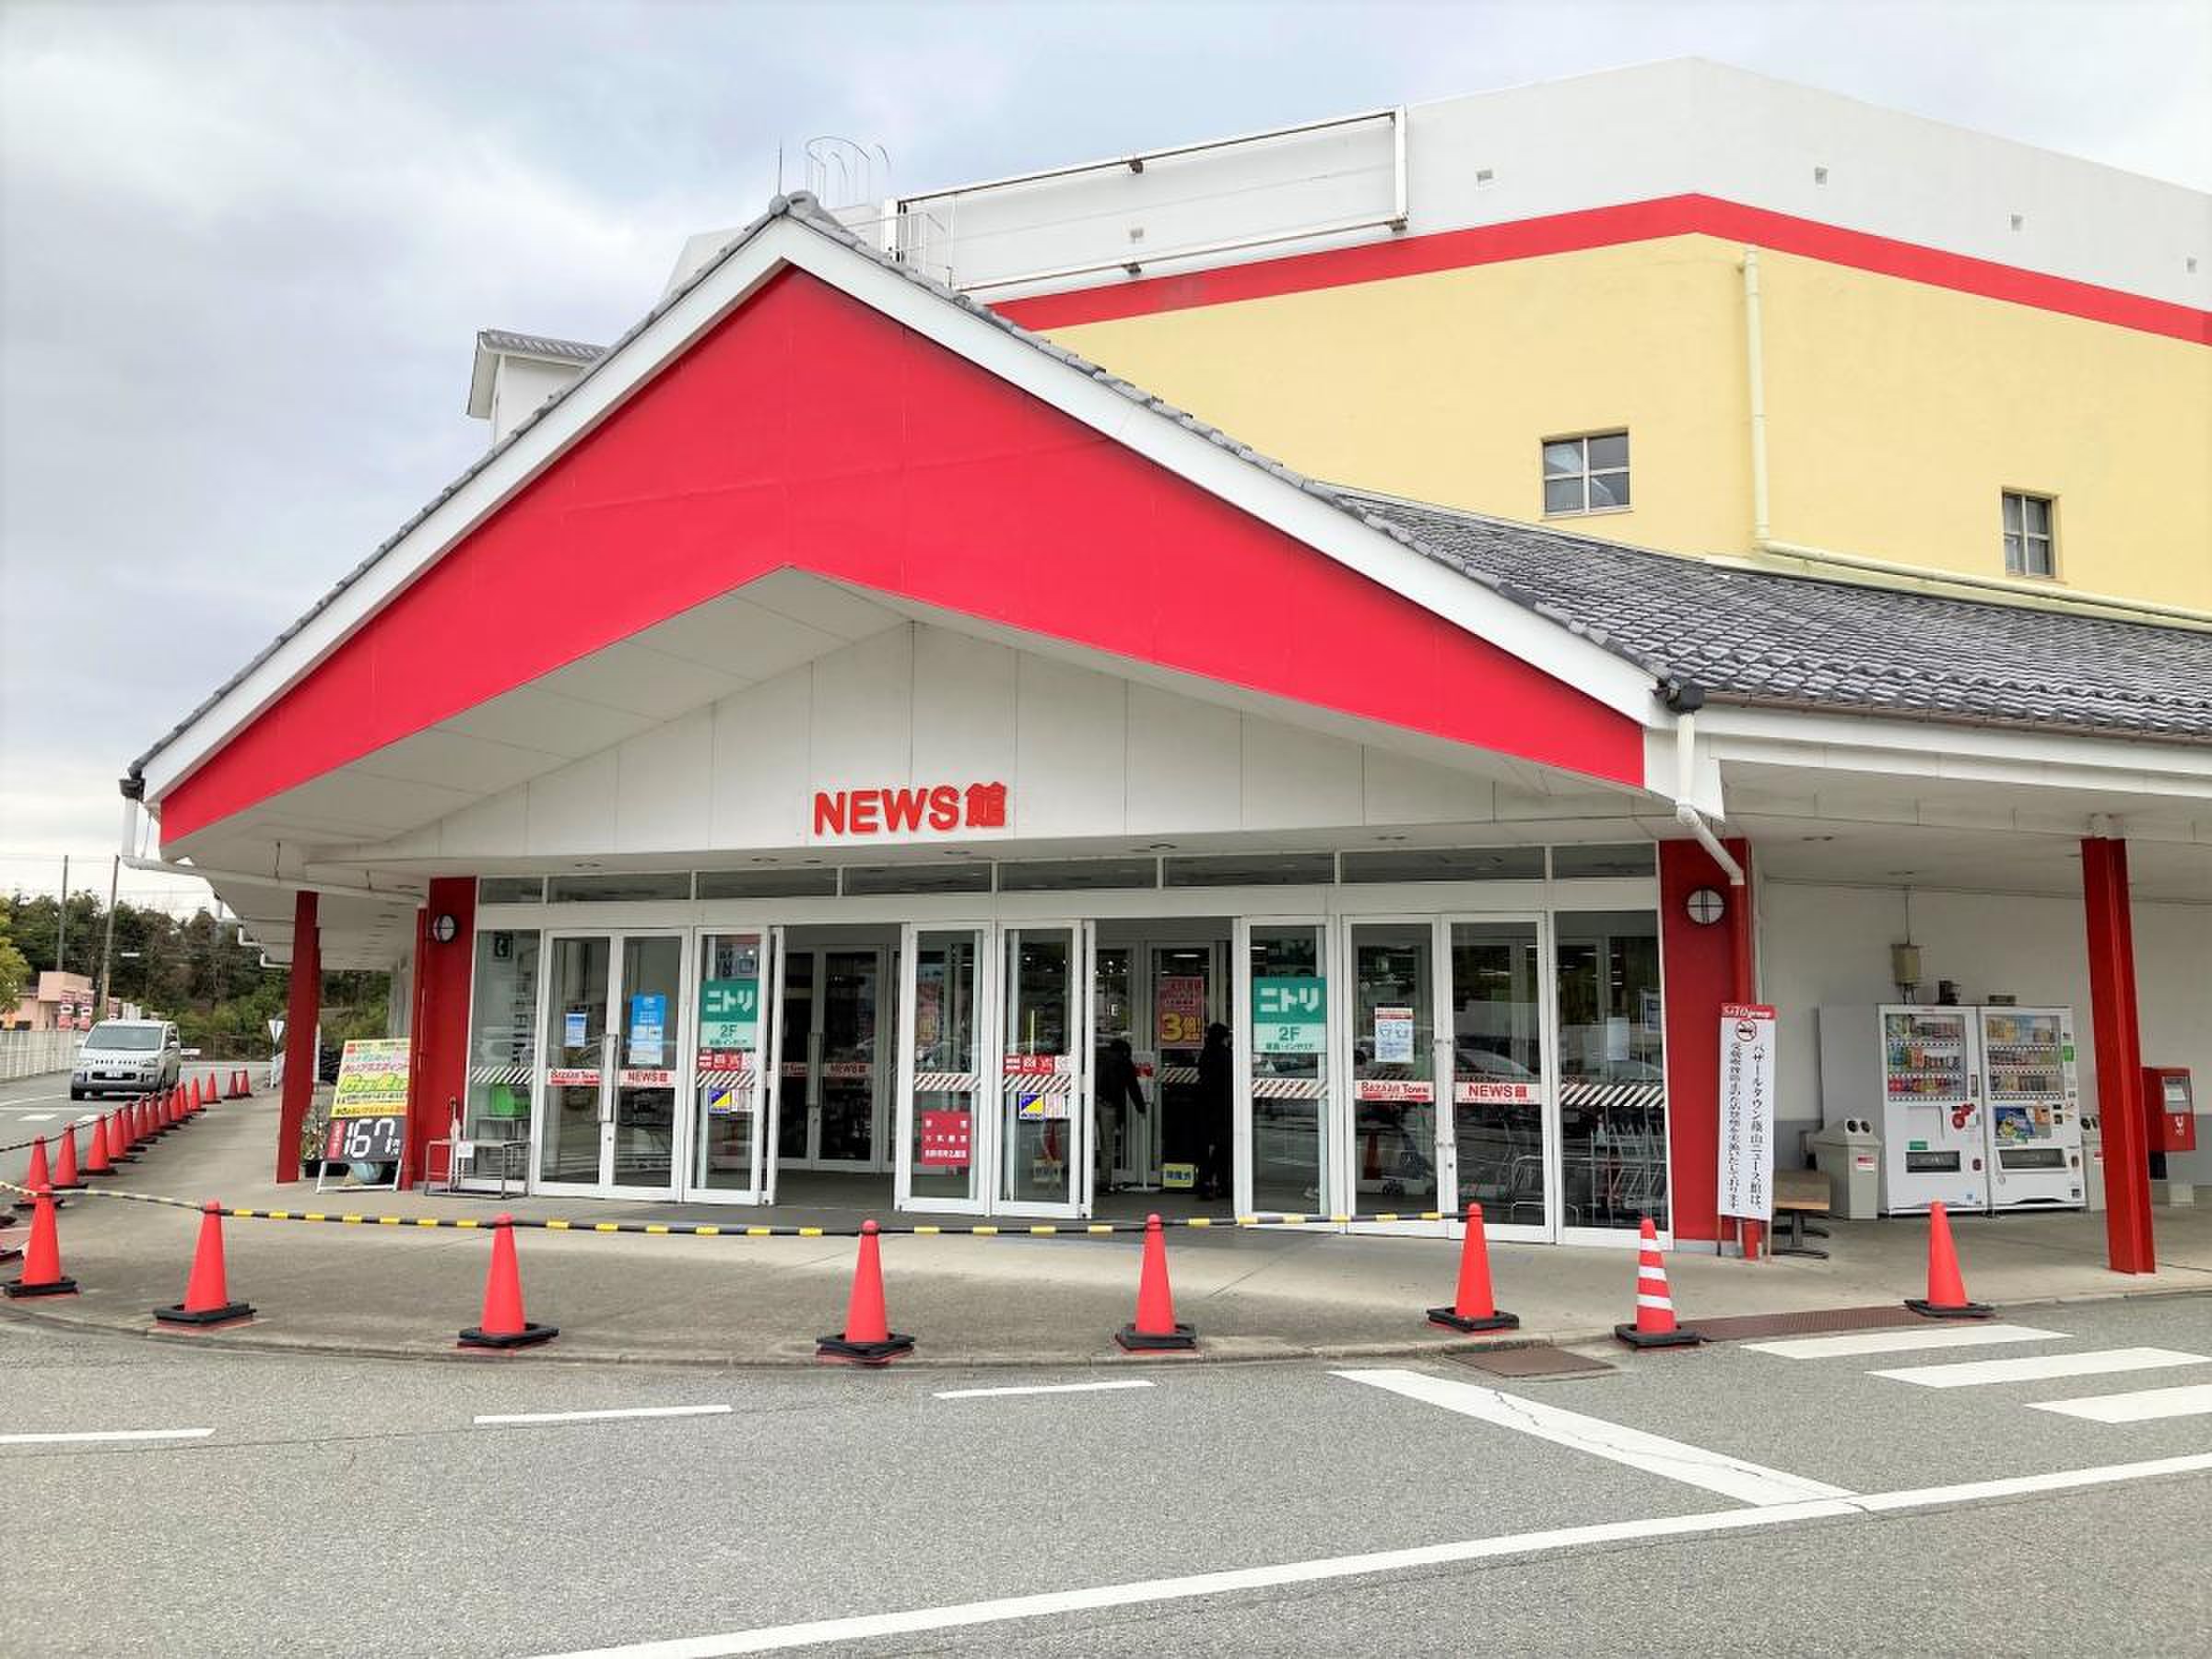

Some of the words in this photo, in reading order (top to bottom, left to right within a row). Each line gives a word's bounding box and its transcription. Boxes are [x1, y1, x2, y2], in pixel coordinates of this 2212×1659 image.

[814, 782, 1006, 836] NEWS館
[707, 990, 752, 1012] ニトリ
[1260, 988, 1319, 1012] ニトリ
[721, 1024, 737, 1038] 2F
[1278, 1026, 1300, 1041] 2F
